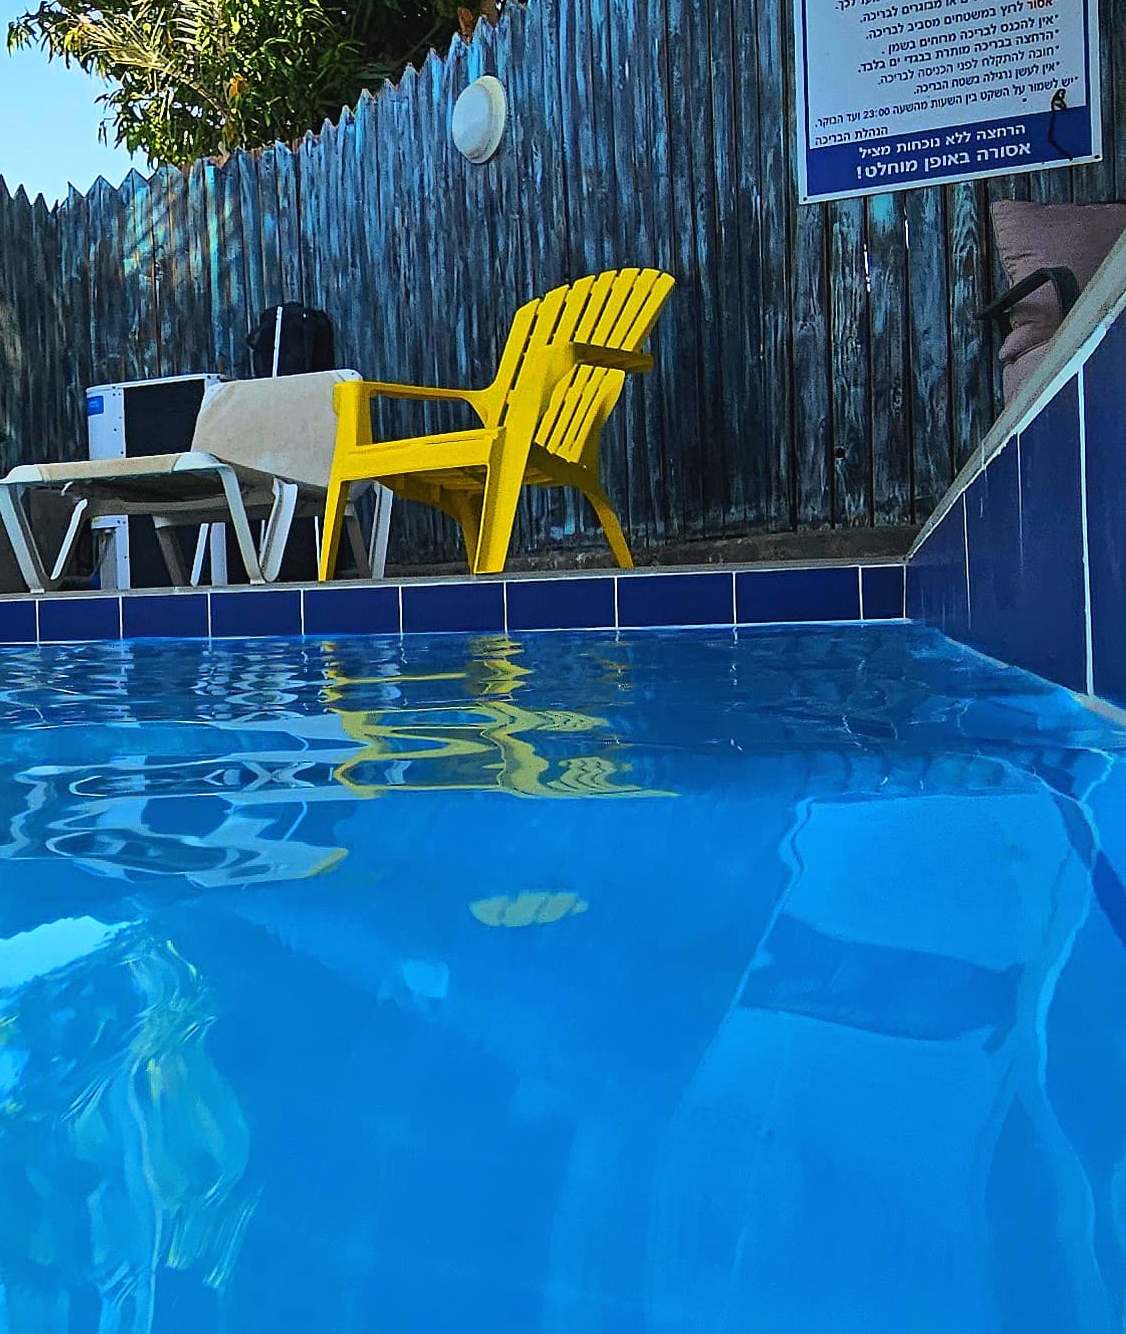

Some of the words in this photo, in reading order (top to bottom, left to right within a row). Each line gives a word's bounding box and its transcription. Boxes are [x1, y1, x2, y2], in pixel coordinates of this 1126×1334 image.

[859, 5, 898, 23] לבריכה.
[901, 0, 942, 14] מבוגרים
[943, 7, 996, 24] במשטחים
[1038, 15, 1053, 28] אין
[865, 22, 904, 39] לבריכה.
[907, 17, 940, 31] מסביב
[1000, 16, 1034, 32] להכנס
[959, 23, 996, 40] לבריכה
[1015, 30, 1053, 45] הרחצה
[888, 39, 916, 55] בשמן
[935, 44, 970, 59] מותרת
[973, 37, 1012, 52] בבריכה
[904, 52, 931, 63] בבגדי
[981, 49, 1024, 67] להתקלח
[1028, 46, 1053, 59] חובה
[857, 59, 885, 72] בלבד.
[889, 57, 900, 67] ים
[956, 57, 978, 71] לפני
[1042, 62, 1054, 75] אין
[877, 68, 914, 84] לבריכה.
[917, 63, 953, 77] הכניסה
[982, 69, 1012, 82] נרגילה
[1015, 63, 1039, 79] לעשן
[913, 80, 948, 94] הבריכה.
[951, 74, 980, 87] בשטח
[1027, 77, 1058, 92] לשמור
[1061, 77, 1073, 86] יש
[979, 87, 1009, 101] השקט
[1012, 83, 1025, 95] על
[930, 94, 962, 108] השעות
[965, 92, 977, 105] בין
[863, 106, 890, 119] 23:00
[892, 100, 928, 114] מהשעה
[846, 112, 860, 122] ועד
[815, 132, 850, 145] הבריכה
[854, 126, 887, 139] הנהלת
[945, 131, 971, 145] ללא
[976, 124, 1025, 140] הרחצה
[858, 145, 890, 158] מציל
[896, 137, 940, 153] נוכחות
[976, 142, 1030, 161] אסורה
[924, 152, 970, 171] באופן
[856, 159, 917, 179] מוחלט!
